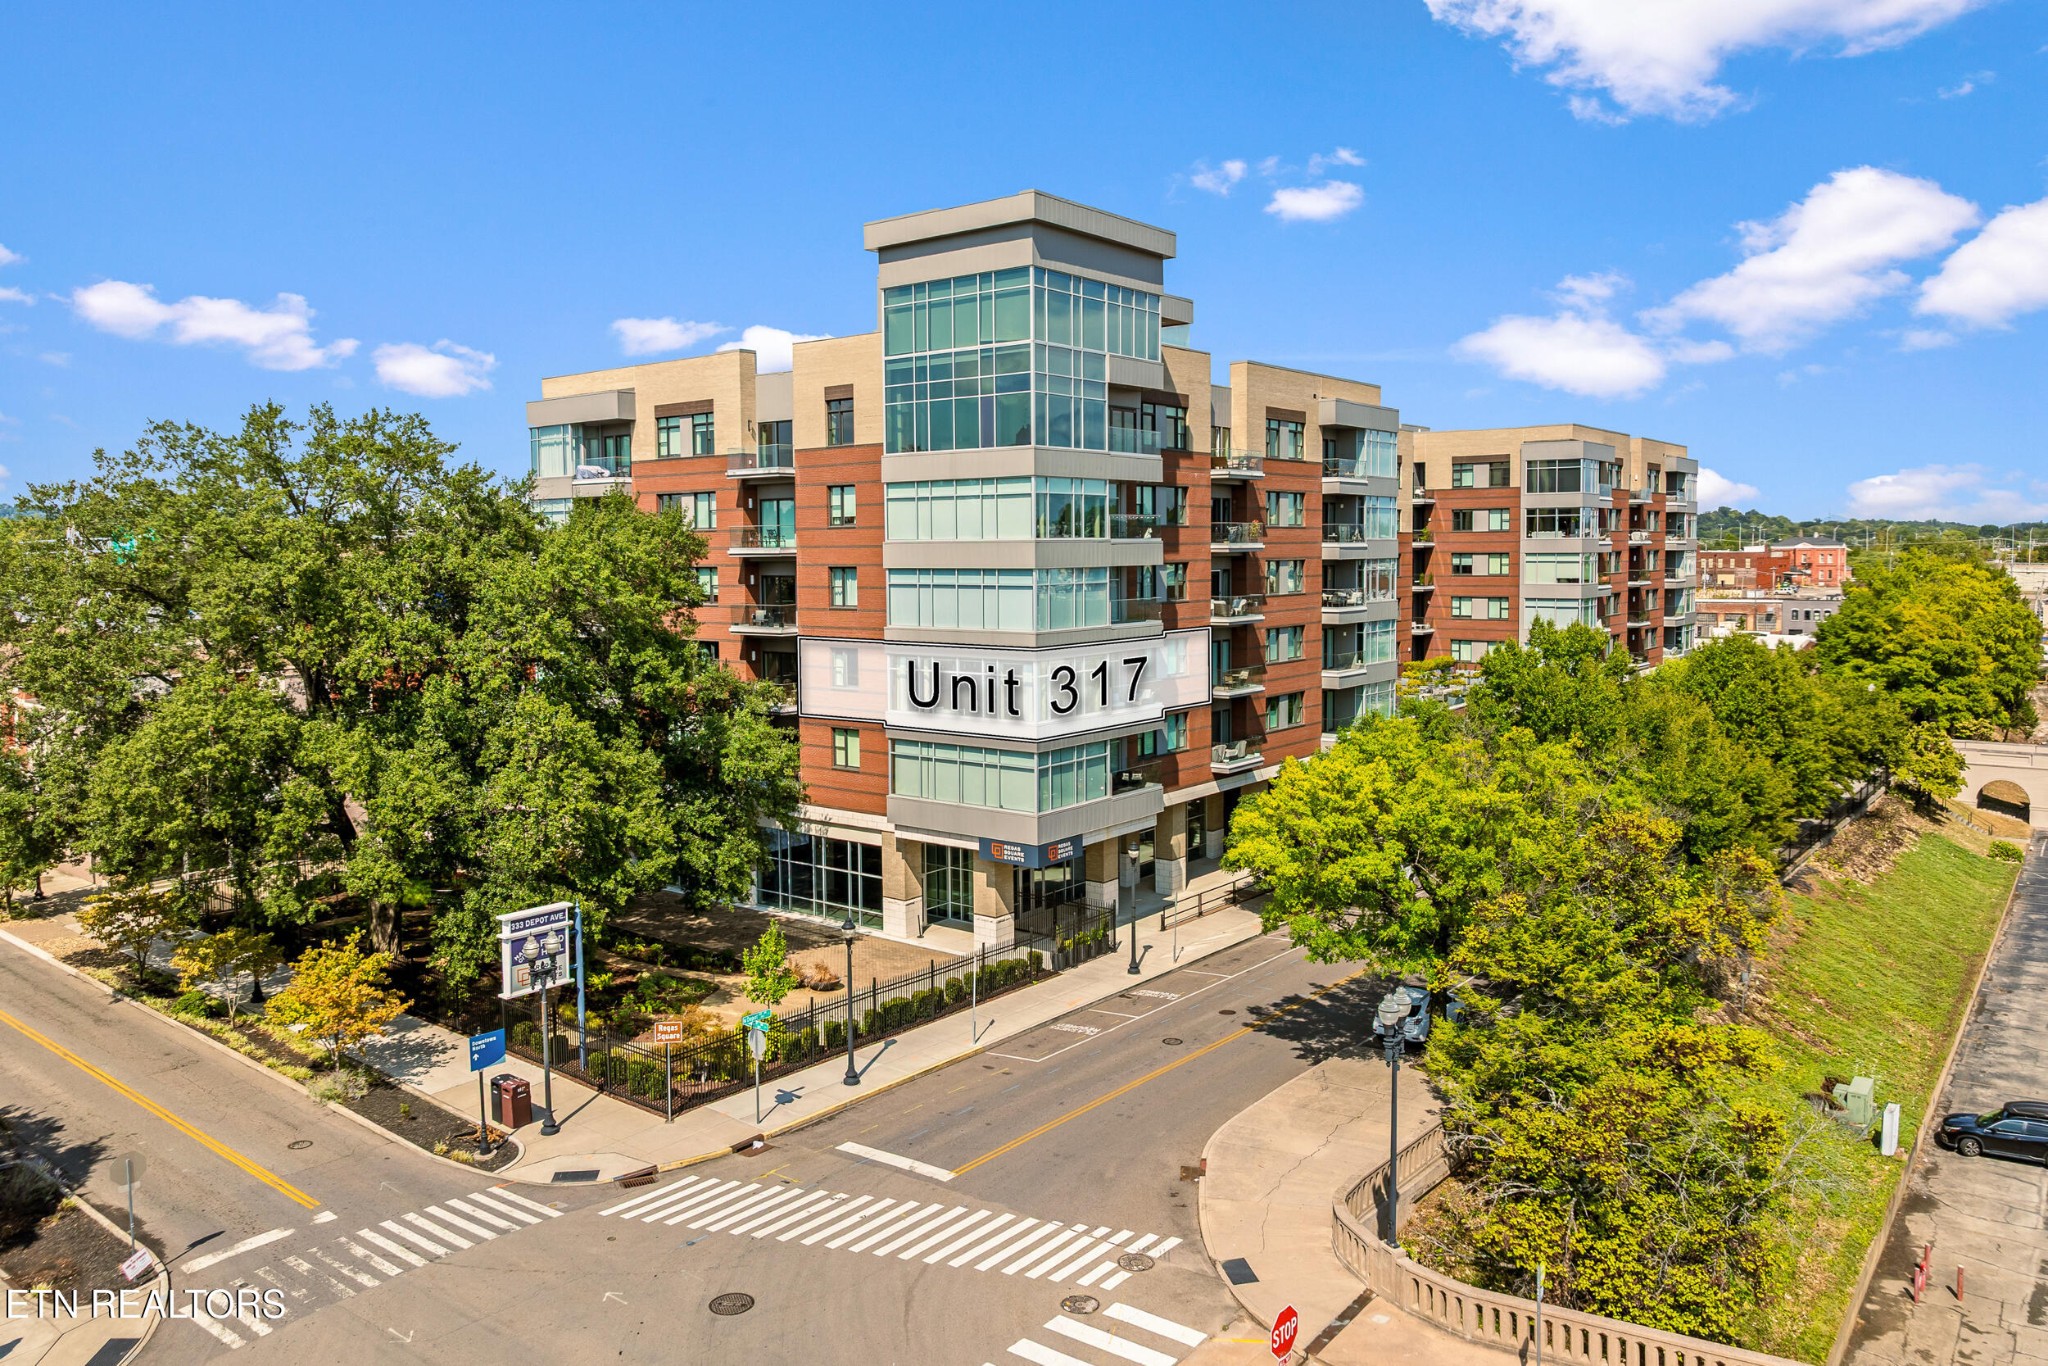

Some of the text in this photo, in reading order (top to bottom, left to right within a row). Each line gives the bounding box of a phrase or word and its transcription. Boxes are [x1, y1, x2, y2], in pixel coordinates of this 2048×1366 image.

[511, 912, 566, 930] 333 DEPOT AVE.
[540, 934, 565, 947] FD
[658, 1024, 678, 1033] Regas
[472, 1036, 497, 1046] Downtown
[657, 1033, 680, 1041] Square
[1273, 1316, 1297, 1349] STOP
